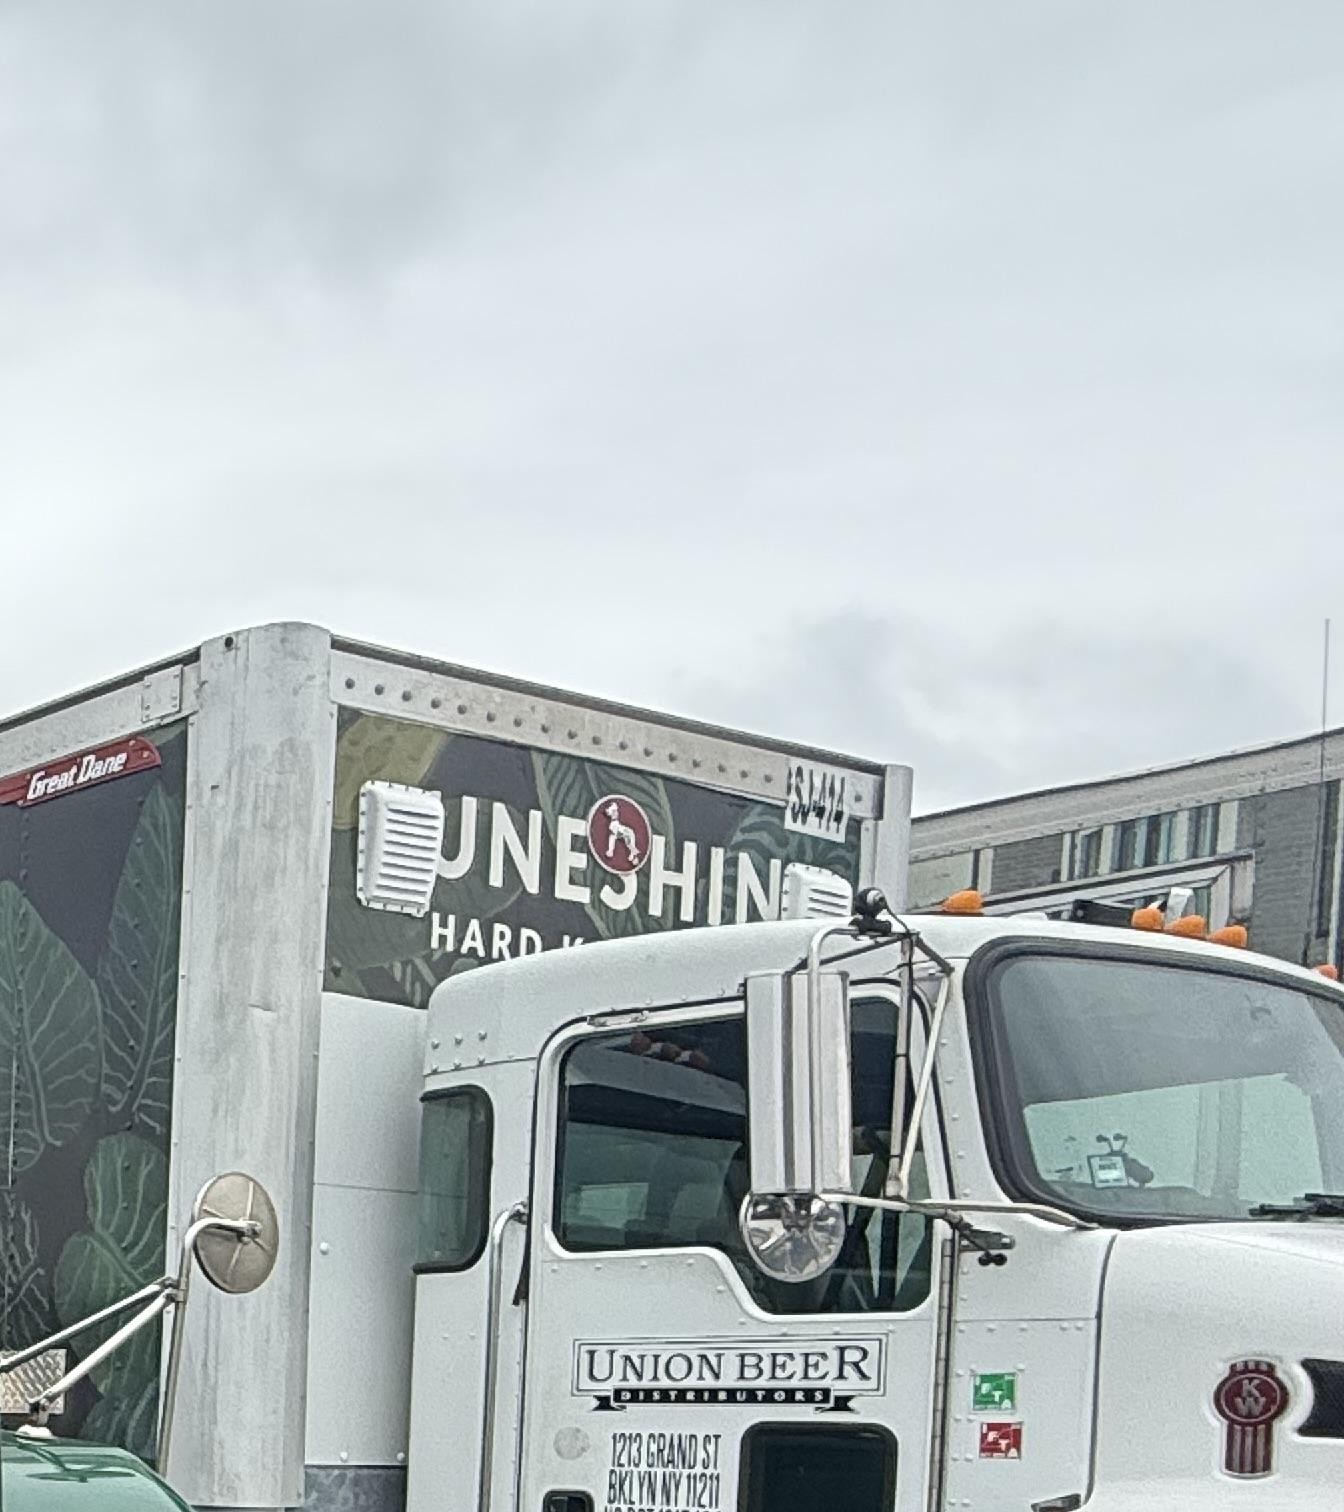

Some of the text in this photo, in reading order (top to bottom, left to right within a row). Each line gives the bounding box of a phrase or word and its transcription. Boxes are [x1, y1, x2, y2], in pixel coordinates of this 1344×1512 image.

[26, 752, 128, 800] Great Dane
[430, 912, 543, 961] HARD
[585, 1345, 872, 1382] UNION BEER
[620, 1389, 825, 1402] DISTRIBUTORS
[612, 1432, 722, 1470] 1213 GRAND ST
[607, 1469, 720, 1509] BKLYN NY 11211
